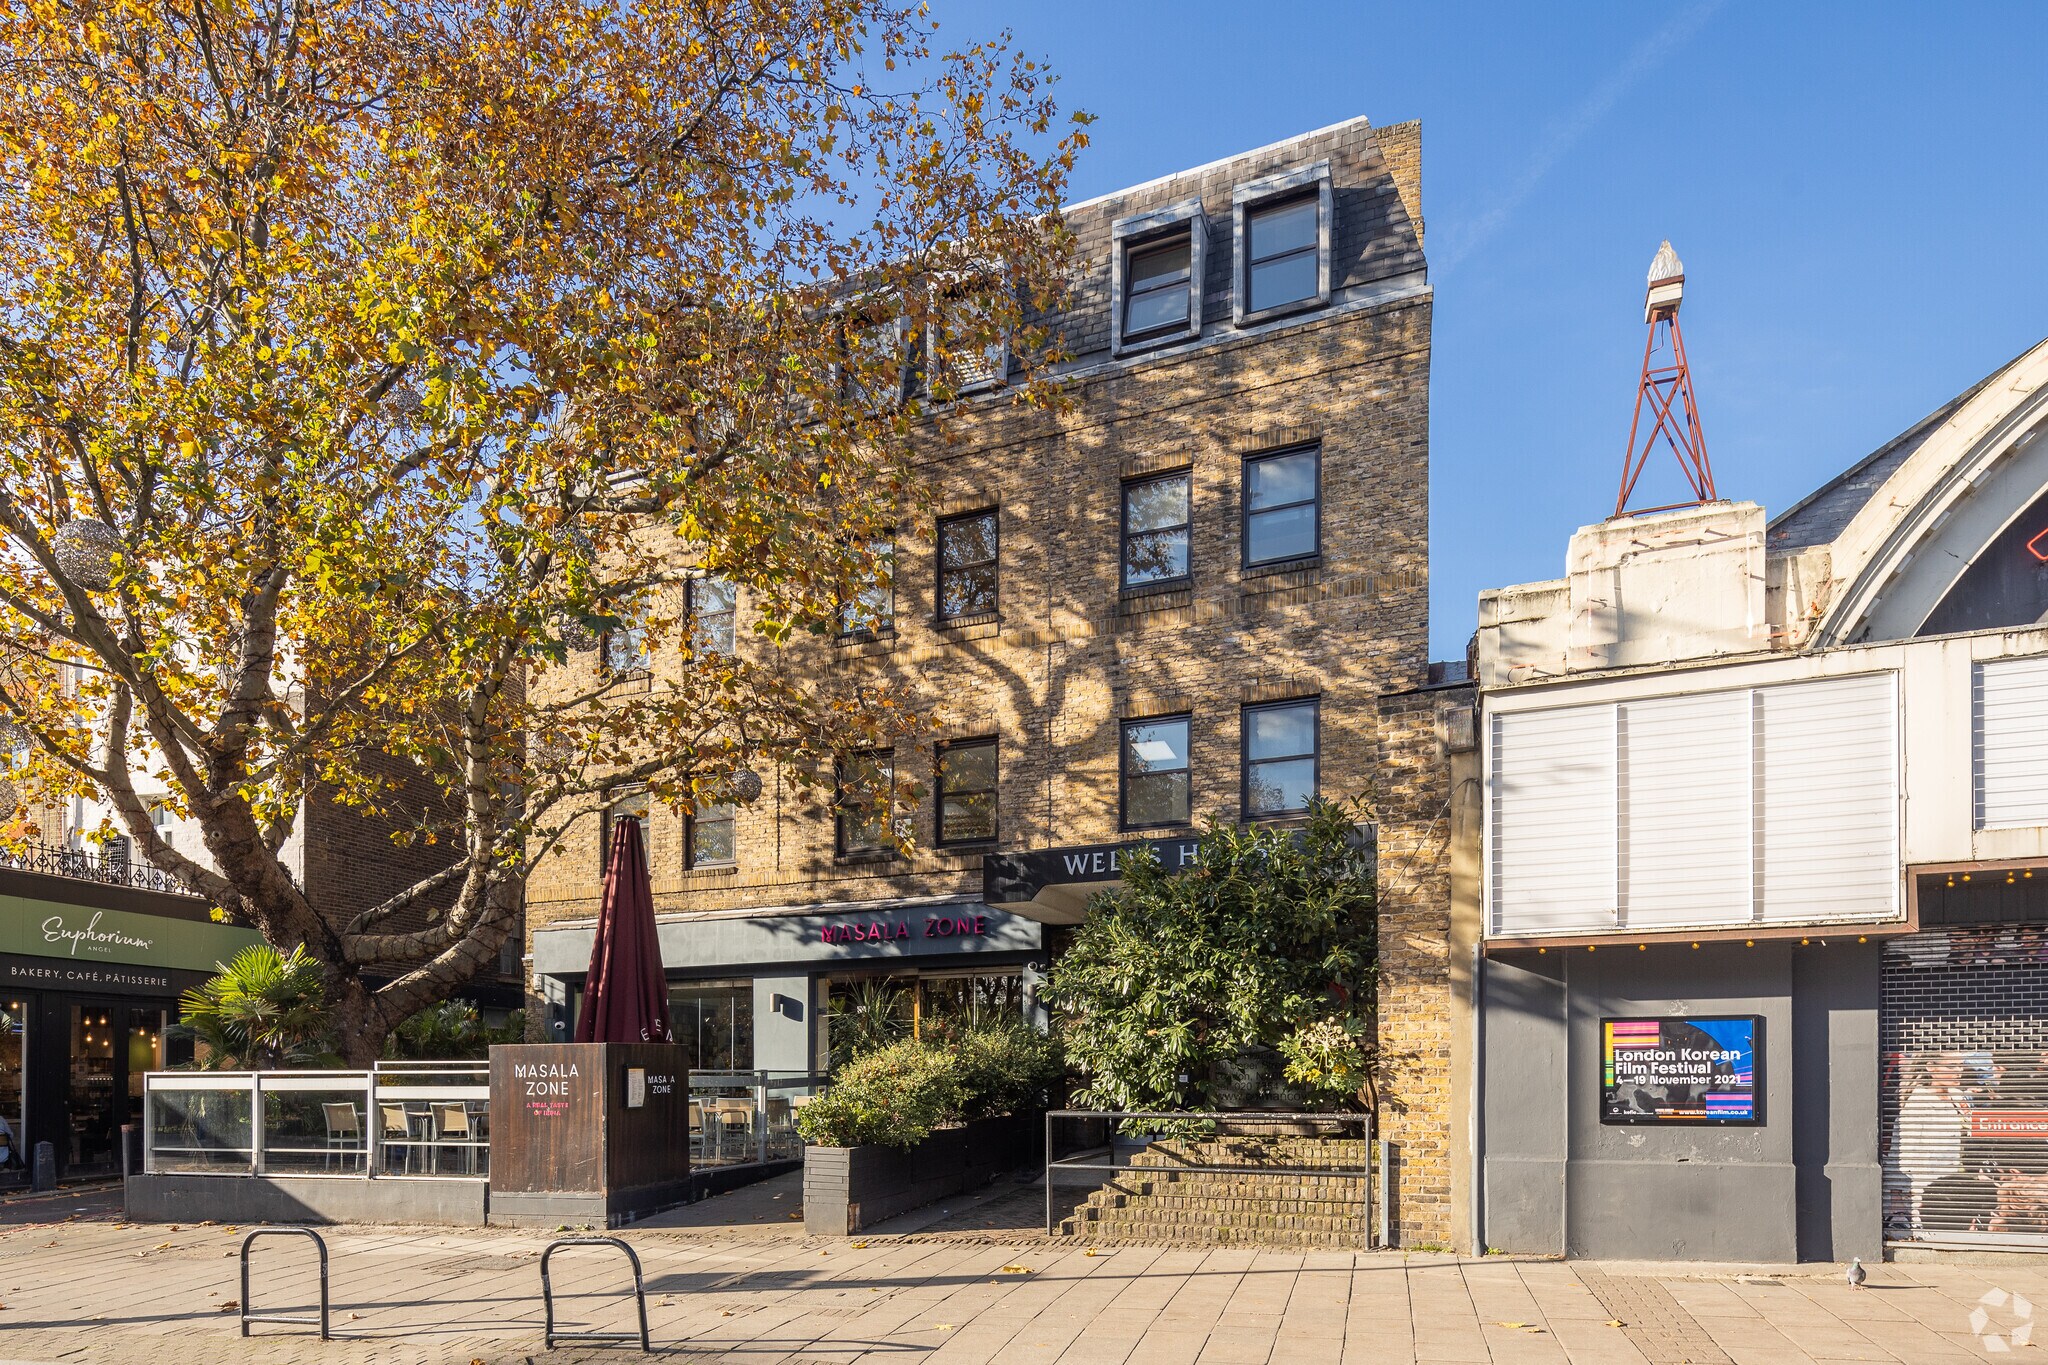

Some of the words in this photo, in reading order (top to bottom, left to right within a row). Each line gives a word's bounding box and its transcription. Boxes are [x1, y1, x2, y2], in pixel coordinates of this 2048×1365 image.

[1063, 846, 1162, 876] WELS
[42, 911, 149, 956] Euphorium
[821, 921, 910, 943] MASALA
[923, 916, 986, 937] ZONE
[11, 966, 62, 980] BAKERY,
[105, 973, 168, 987] PÂTISSERIE
[1615, 1049, 1676, 1062] London
[1681, 1048, 1741, 1061] Korean
[515, 1063, 579, 1078] MASALA
[1615, 1062, 1647, 1075] Film
[1651, 1061, 1711, 1075] Festival
[1650, 1075, 1711, 1085] November
[1714, 1074, 1741, 1084] 2021
[526, 1081, 569, 1096] ZONE
[652, 1085, 671, 1094] ZONE
[1679, 1108, 1748, 1116] www.koreanfilm.co.uk
